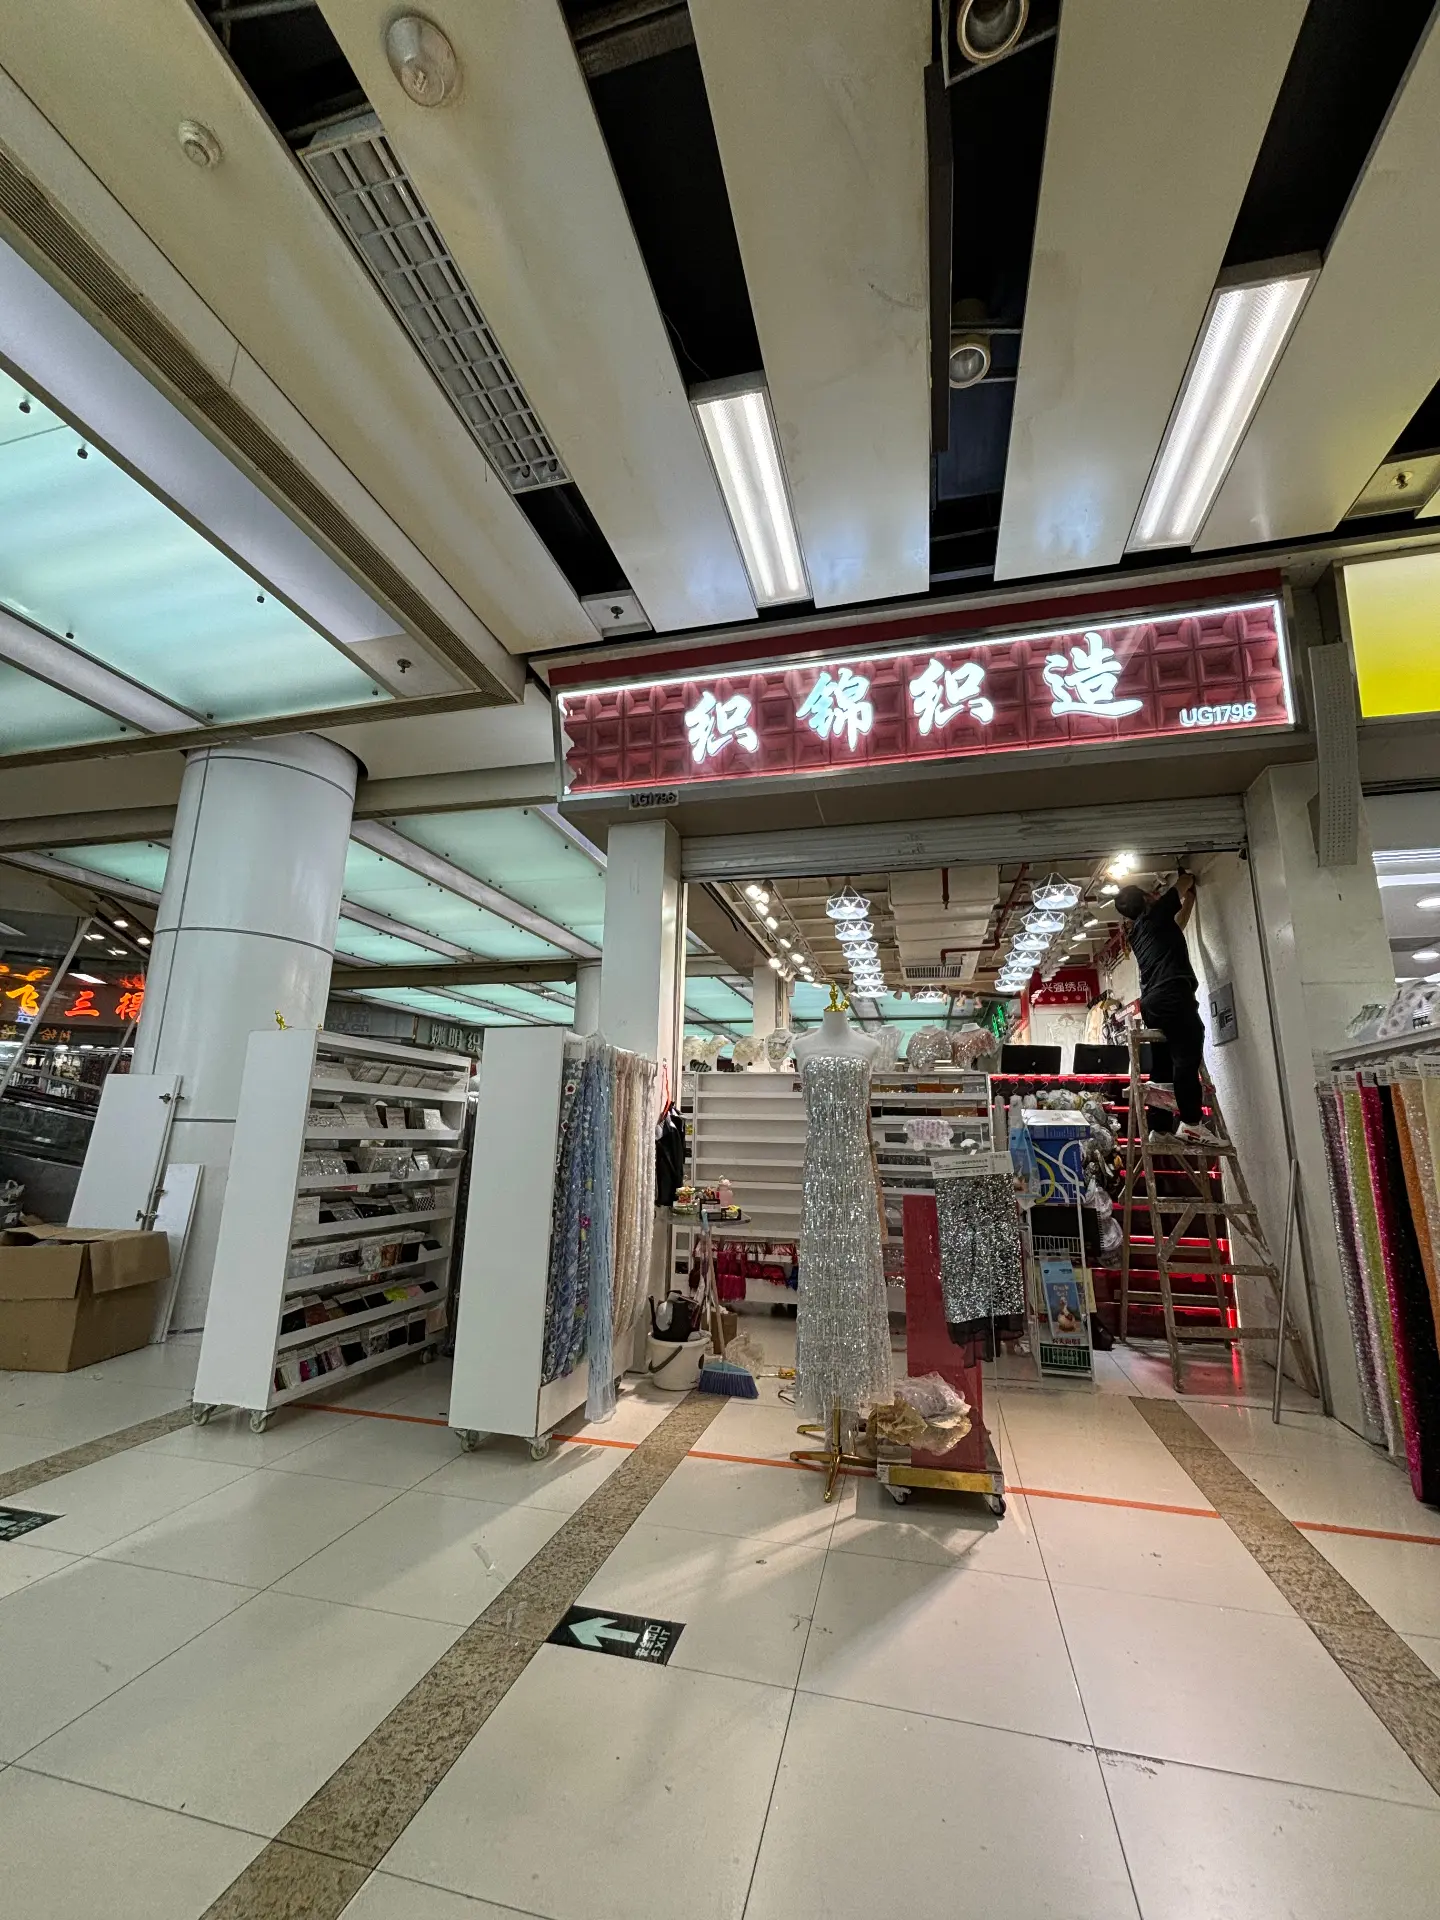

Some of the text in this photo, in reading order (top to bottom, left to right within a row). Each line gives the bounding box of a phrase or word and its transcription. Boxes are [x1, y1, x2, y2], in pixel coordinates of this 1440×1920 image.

[1179, 702, 1257, 727] UG1796
[1041, 981, 1089, 993] 兴强绣品
[651, 1629, 671, 1657] EXIT
